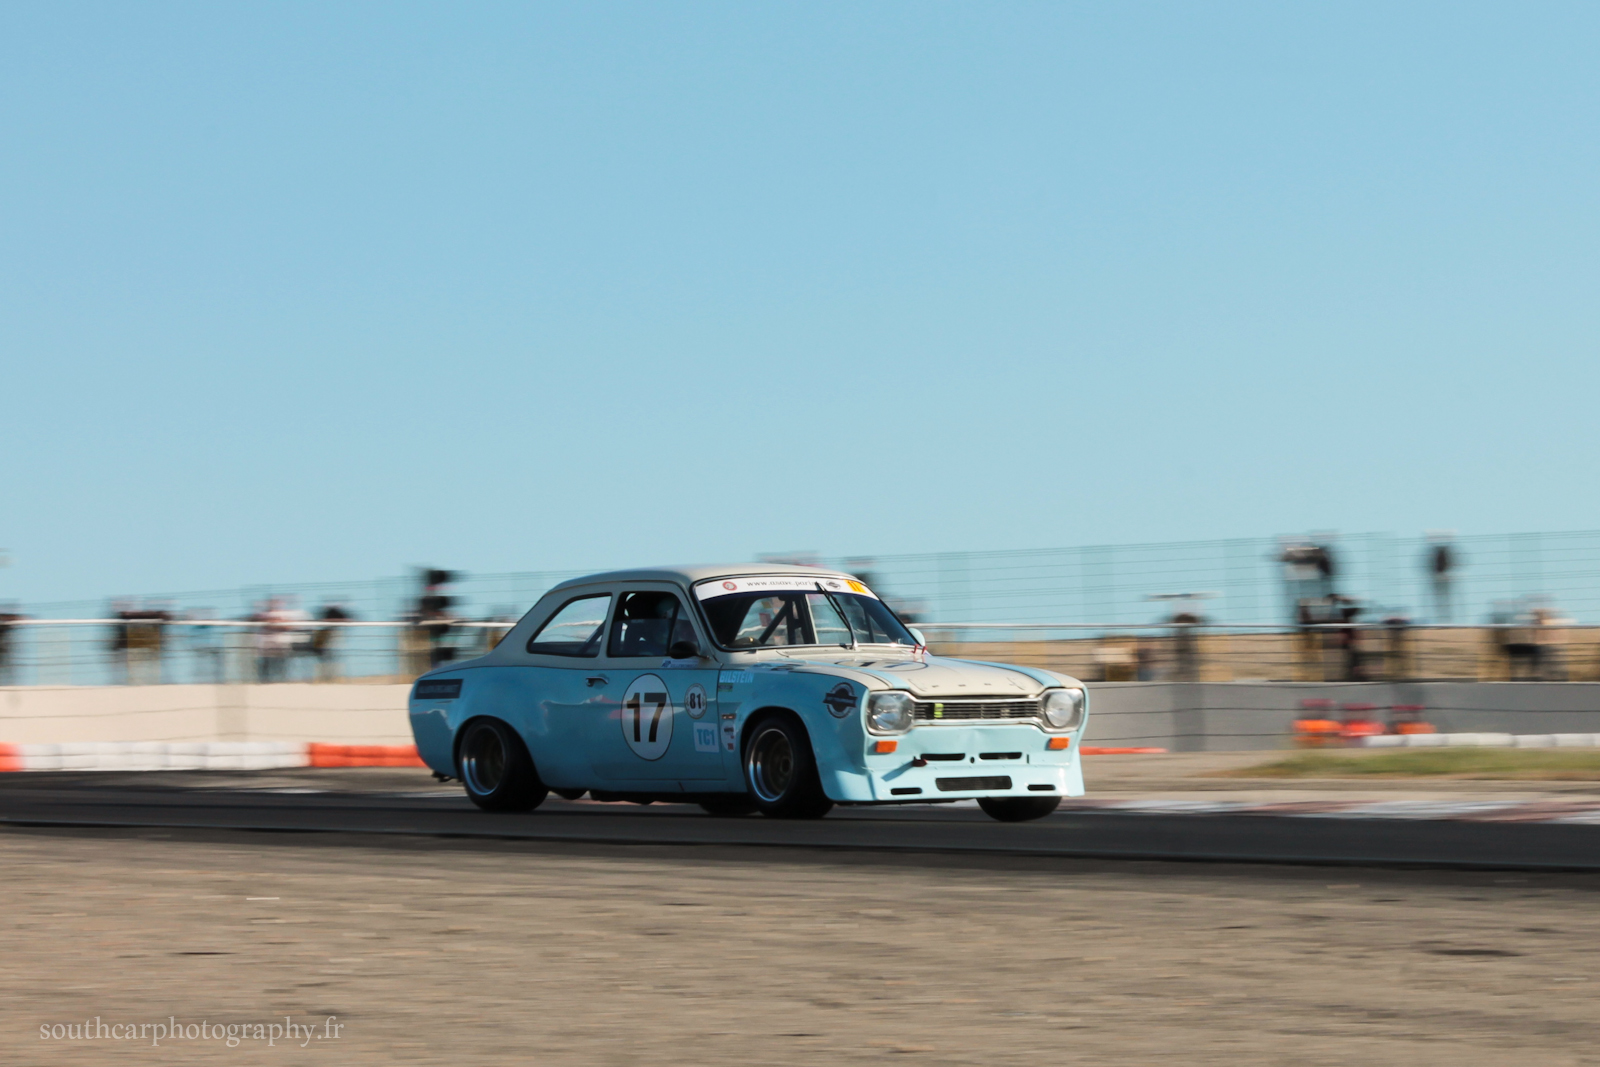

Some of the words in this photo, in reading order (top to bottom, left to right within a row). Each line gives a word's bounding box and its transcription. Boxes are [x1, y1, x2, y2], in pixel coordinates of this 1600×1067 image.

[719, 670, 754, 683] BILSTEIN
[690, 692, 702, 709] 81
[627, 692, 667, 742] 17
[697, 728, 716, 746] TC1
